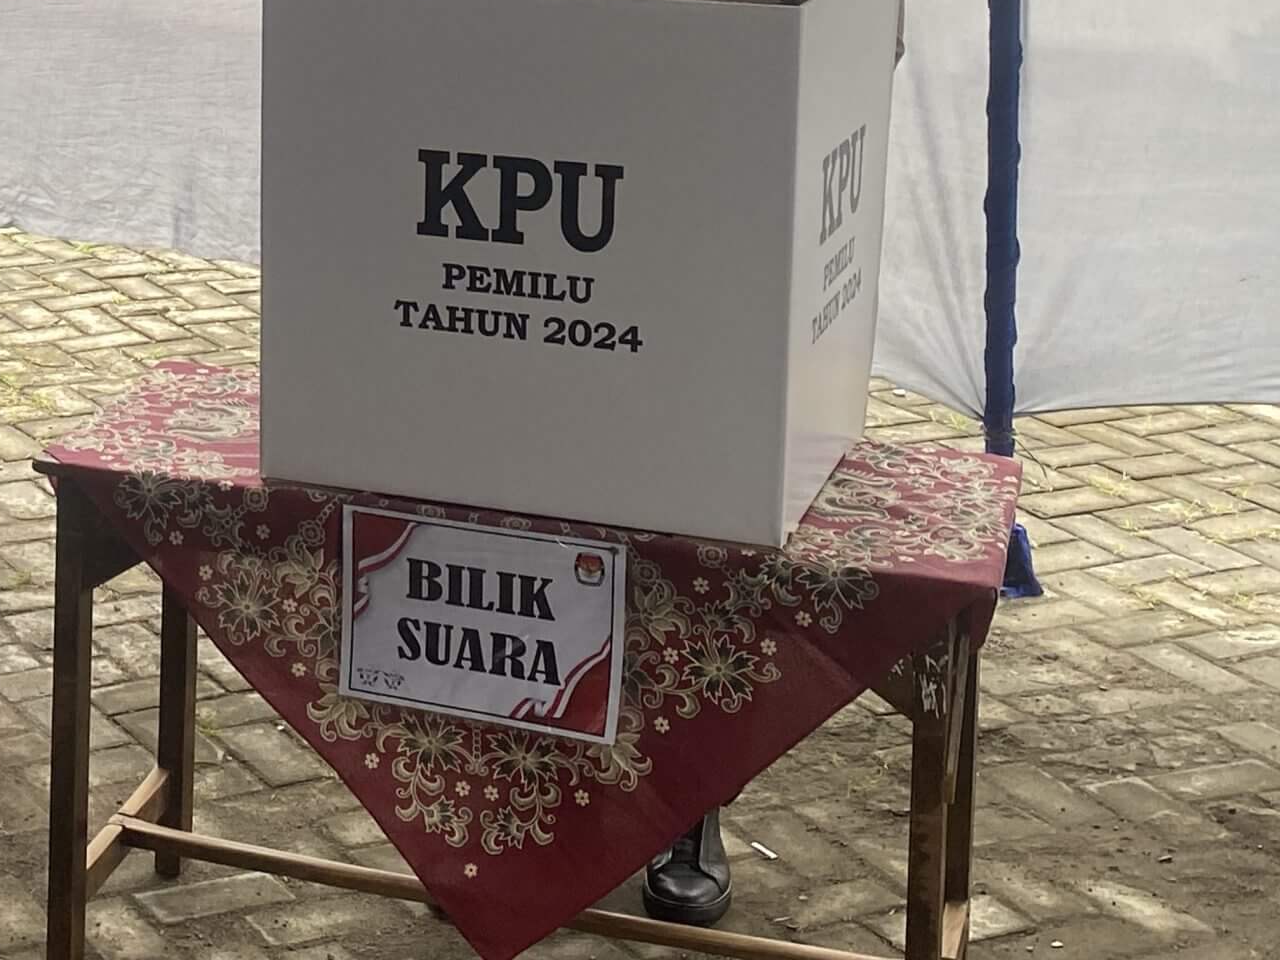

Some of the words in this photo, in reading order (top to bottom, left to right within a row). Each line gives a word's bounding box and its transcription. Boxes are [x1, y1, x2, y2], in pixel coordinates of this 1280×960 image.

[416, 148, 624, 253] KPU
[820, 123, 866, 246] KPU
[441, 263, 595, 304] PEMILU
[822, 236, 855, 291] PEMILU
[394, 299, 530, 340] TAHUN
[543, 316, 643, 353] 2024
[811, 291, 841, 345] TAHUN
[840, 267, 862, 311] 2024
[406, 558, 556, 622] BILIK
[396, 617, 561, 687] SUARA
